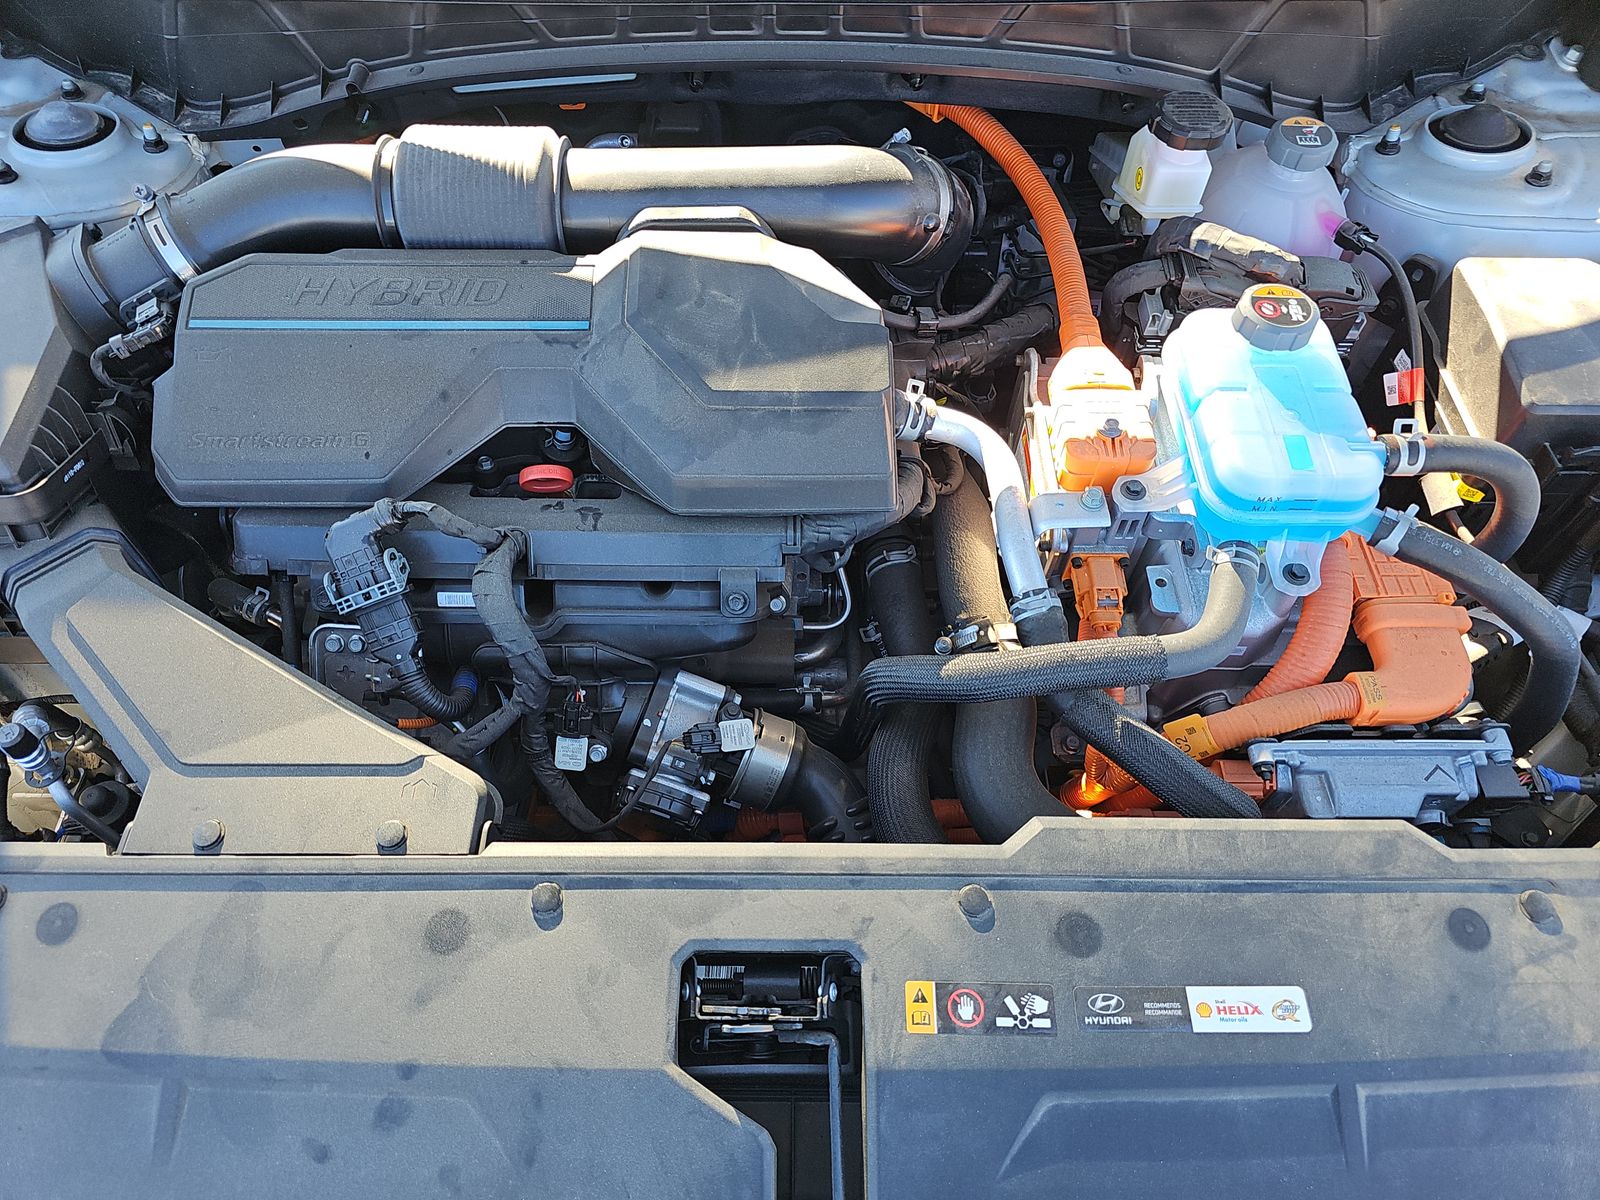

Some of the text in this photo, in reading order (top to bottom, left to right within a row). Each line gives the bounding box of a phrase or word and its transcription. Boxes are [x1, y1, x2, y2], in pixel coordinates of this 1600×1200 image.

[291, 276, 509, 307] HYBRID
[189, 431, 371, 450] Smartstream G
[1368, 675, 1383, 701] PASS
[1216, 1003, 1264, 1016] HELIX
[1084, 1016, 1133, 1025] HYUNDAI
